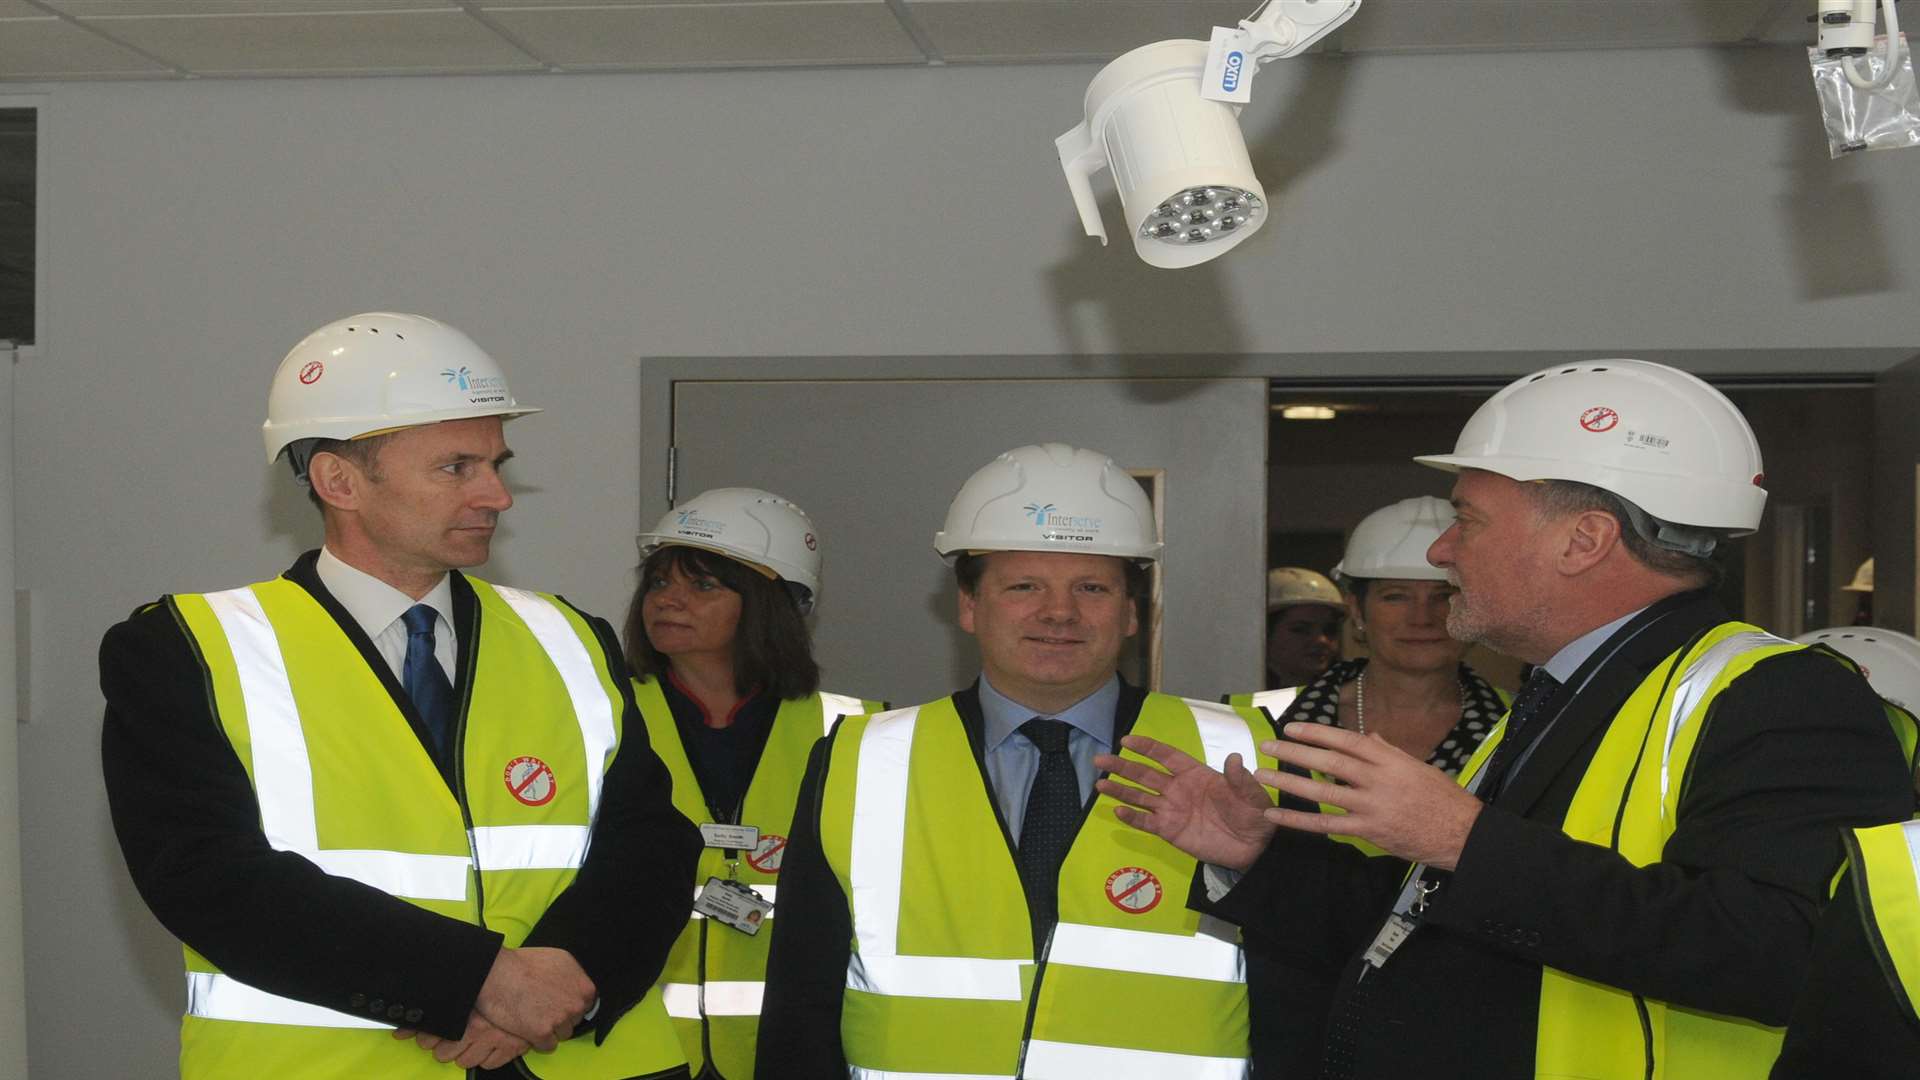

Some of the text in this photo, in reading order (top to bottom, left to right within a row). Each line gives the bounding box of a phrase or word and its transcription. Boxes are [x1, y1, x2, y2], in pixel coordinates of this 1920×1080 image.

[1224, 55, 1241, 88] LUXO
[469, 396, 505, 404] VISITOR
[1048, 513, 1103, 529] Interserve
[1042, 534, 1094, 542] VISITOR
